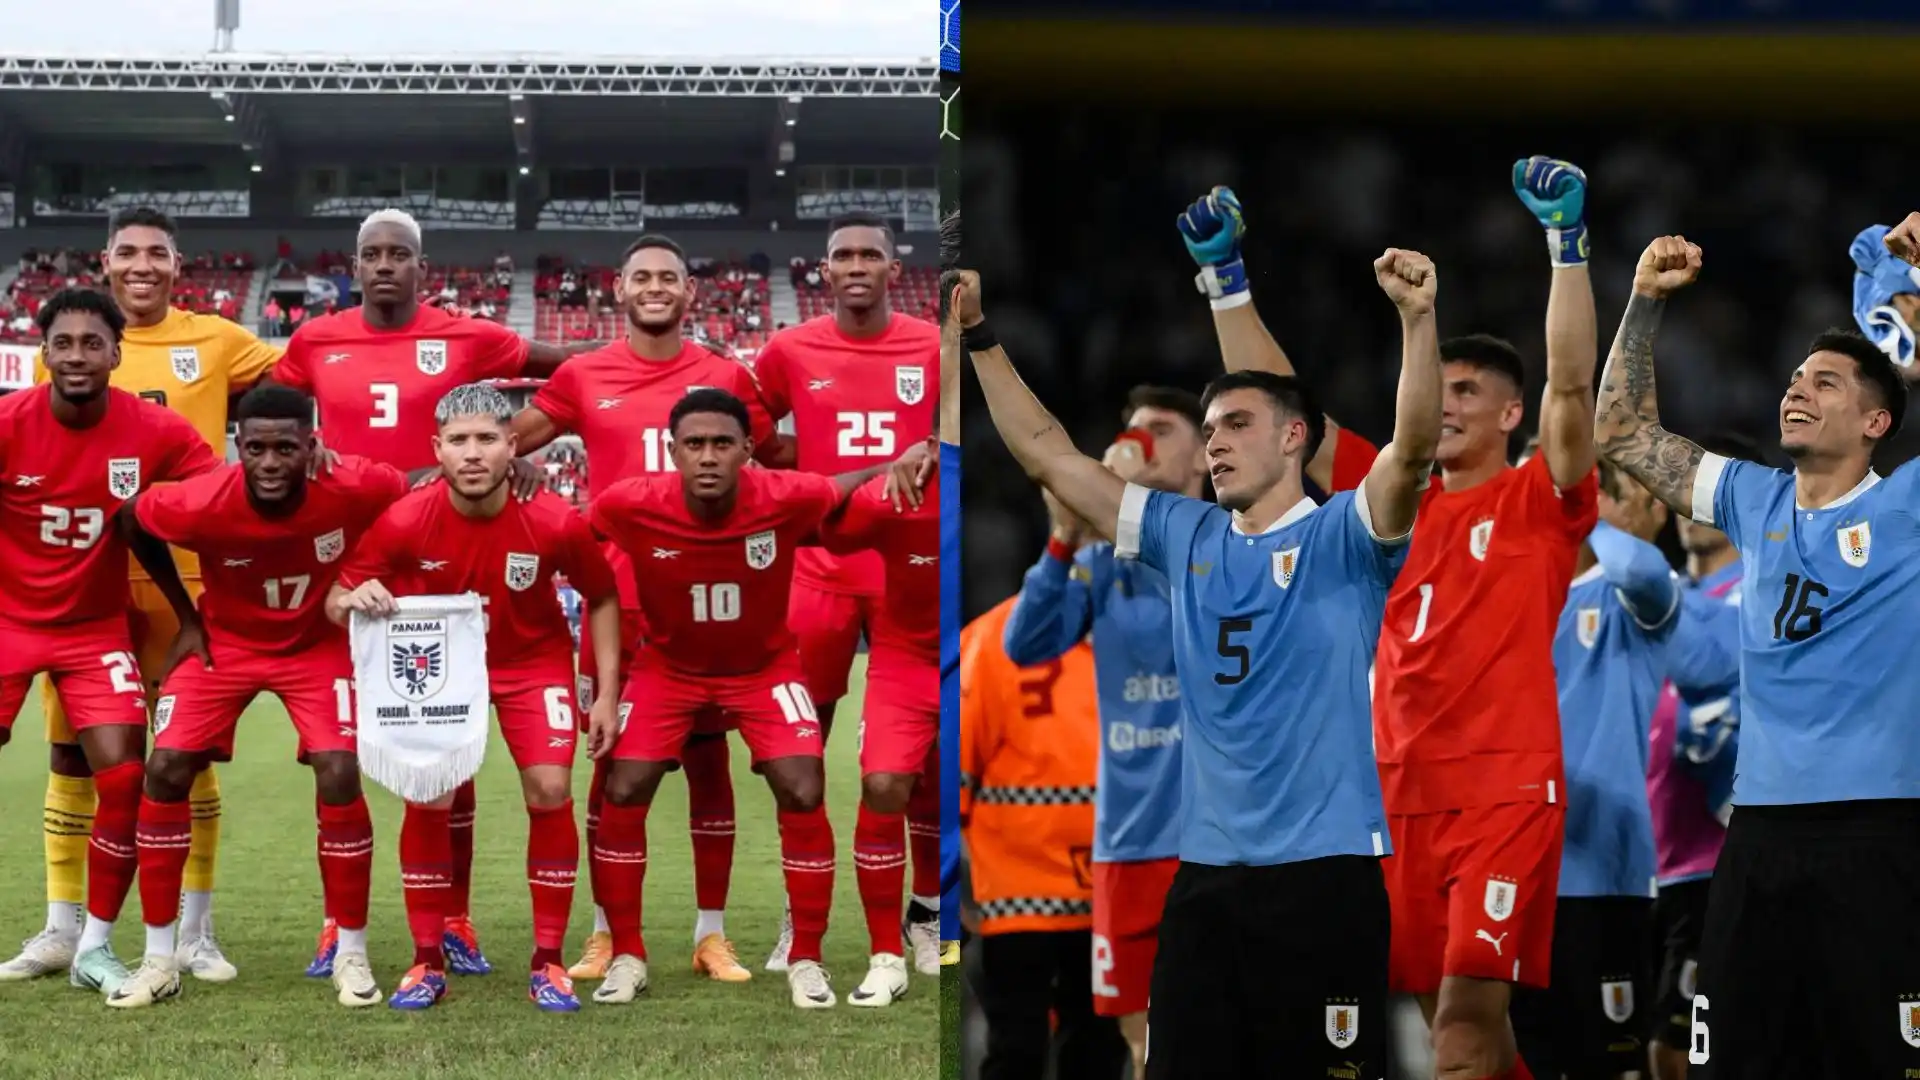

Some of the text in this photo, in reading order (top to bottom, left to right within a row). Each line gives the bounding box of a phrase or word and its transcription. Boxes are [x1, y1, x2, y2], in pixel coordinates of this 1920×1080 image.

[0, 350, 22, 382] R
[369, 383, 398, 428] 3
[837, 412, 896, 456] 25
[40, 504, 103, 549] 23
[263, 574, 310, 610] 17
[689, 583, 740, 622] 10
[1408, 584, 1433, 642] 1
[1774, 573, 1829, 642] 16
[391, 620, 442, 634] PANAMÁ
[1214, 620, 1252, 686] 5
[421, 704, 470, 718] PARAGUAY
[544, 686, 573, 731] 6
[772, 682, 818, 723] 10
[1327, 1067, 1357, 1080] PUMA
